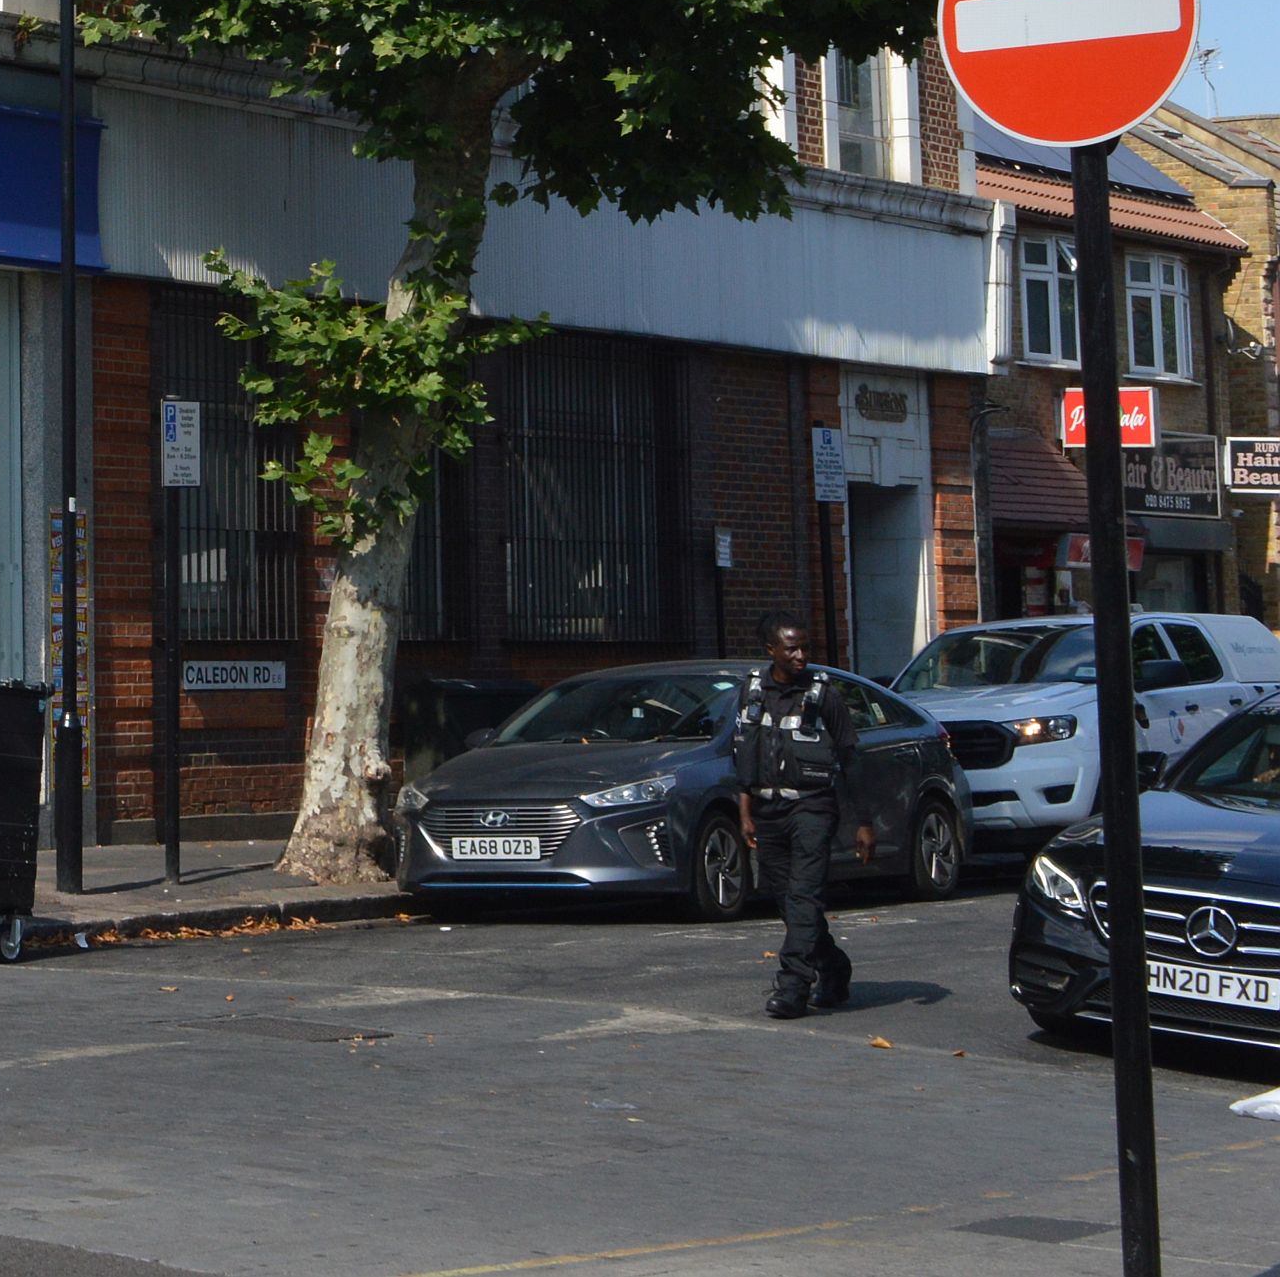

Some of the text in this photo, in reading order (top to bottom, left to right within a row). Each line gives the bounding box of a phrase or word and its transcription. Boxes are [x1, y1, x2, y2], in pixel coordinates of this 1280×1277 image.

[1237, 453, 1280, 467] Hair
[1150, 455, 1163, 491] &
[1166, 456, 1217, 502] Beauty
[186, 666, 248, 684] CALEDON
[254, 666, 271, 684] RD
[458, 840, 533, 855] EA68 OZB
[1146, 964, 1269, 1003] HN20 FXD
